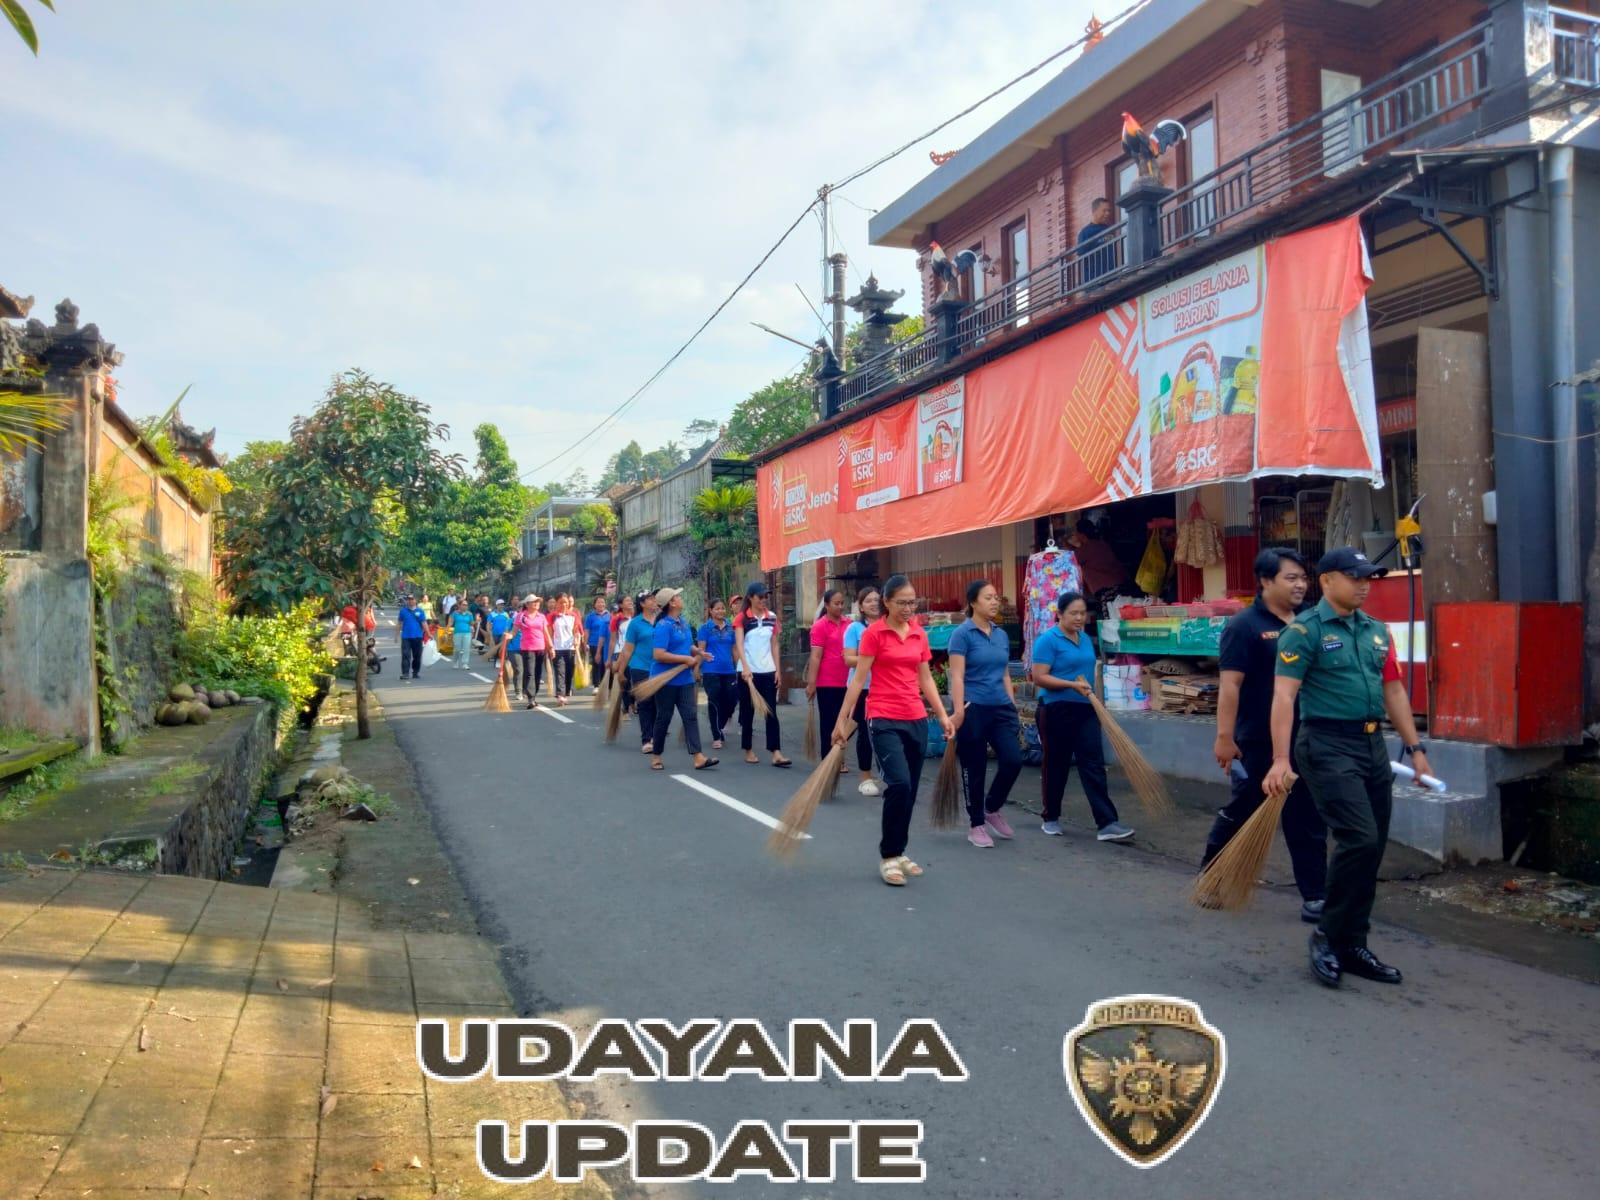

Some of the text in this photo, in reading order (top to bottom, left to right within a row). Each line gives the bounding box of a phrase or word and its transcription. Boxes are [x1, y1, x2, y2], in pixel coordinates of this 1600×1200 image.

[1151, 264, 1250, 320] SOLUSI BELANJA
[1174, 298, 1220, 333] HARIAN
[1188, 444, 1217, 471] SRC
[856, 462, 874, 481] SRC
[808, 491, 832, 509] Jero
